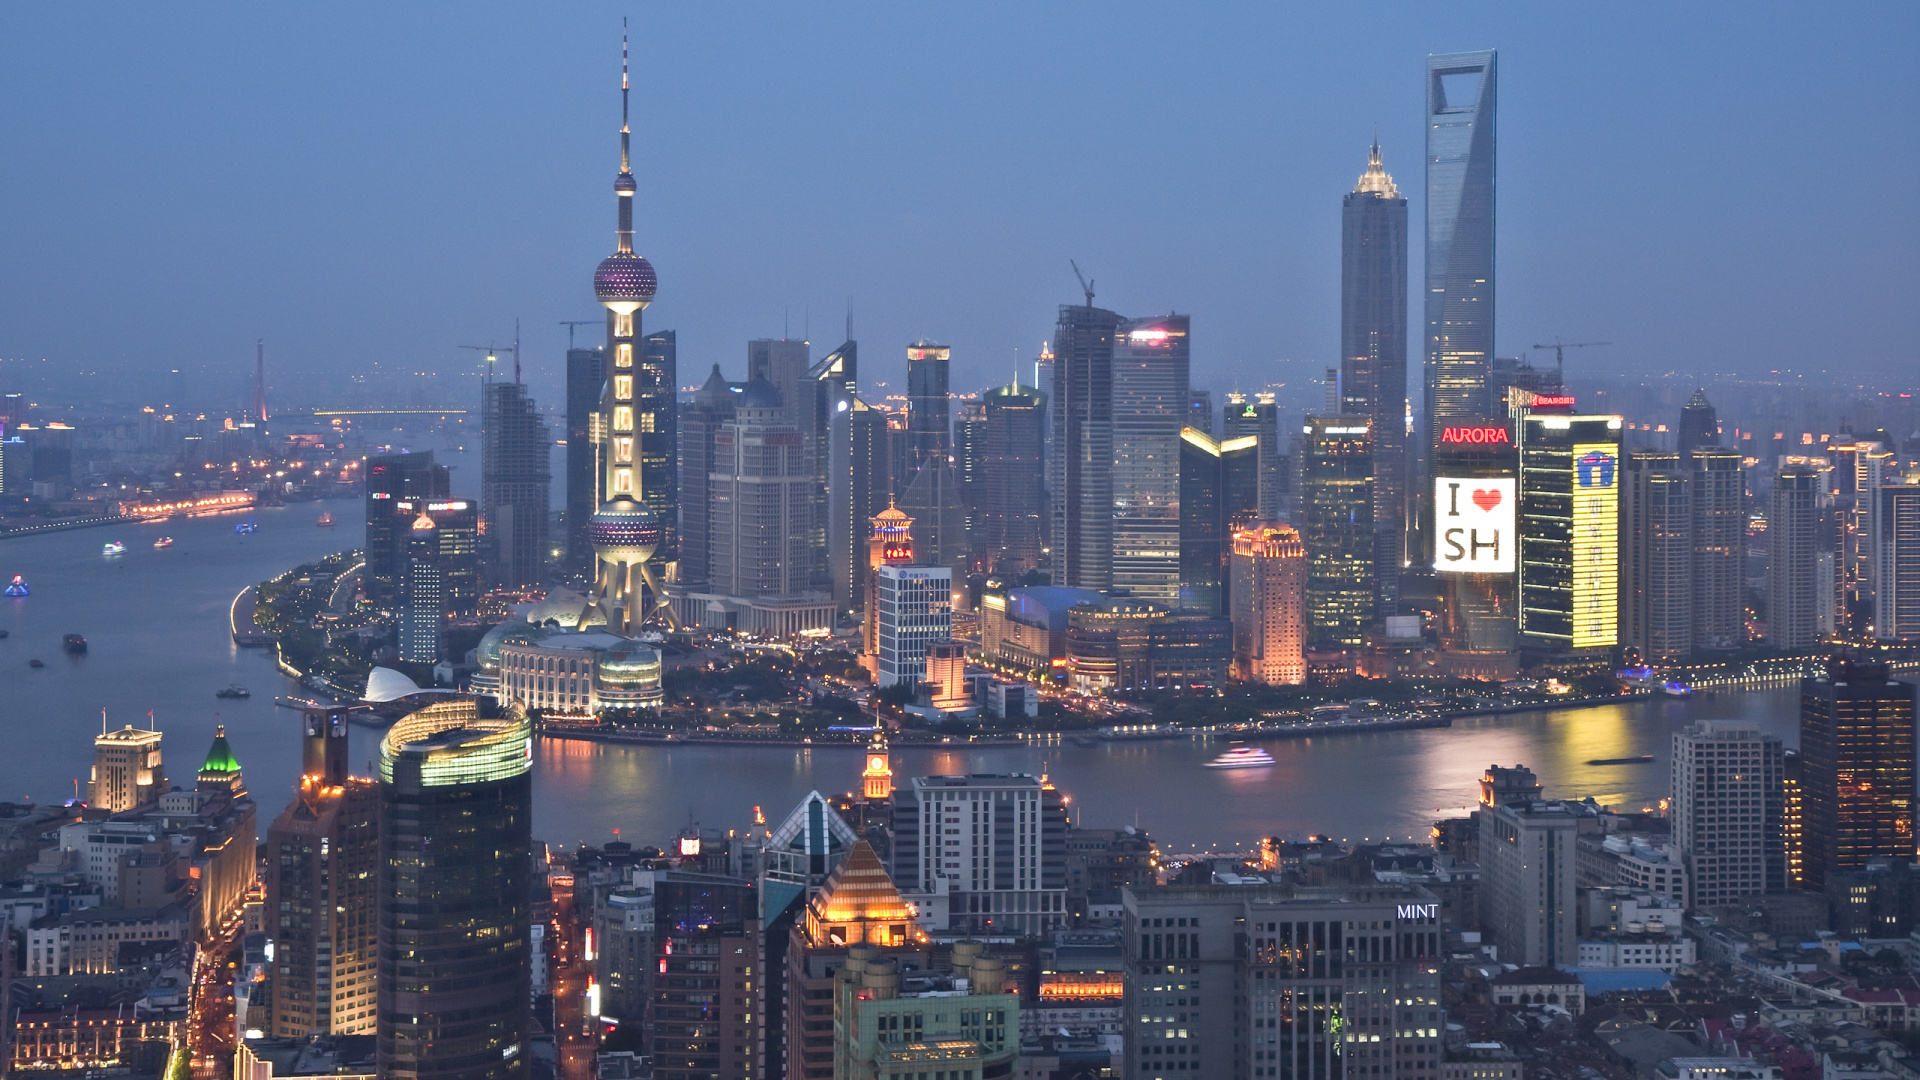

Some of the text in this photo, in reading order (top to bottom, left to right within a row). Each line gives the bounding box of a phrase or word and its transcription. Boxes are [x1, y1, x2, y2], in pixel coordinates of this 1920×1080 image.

[1441, 427, 1508, 443] AURORA
[1448, 483, 1460, 516] I
[1445, 528, 1499, 561] SH
[1397, 903, 1438, 919] MINT
